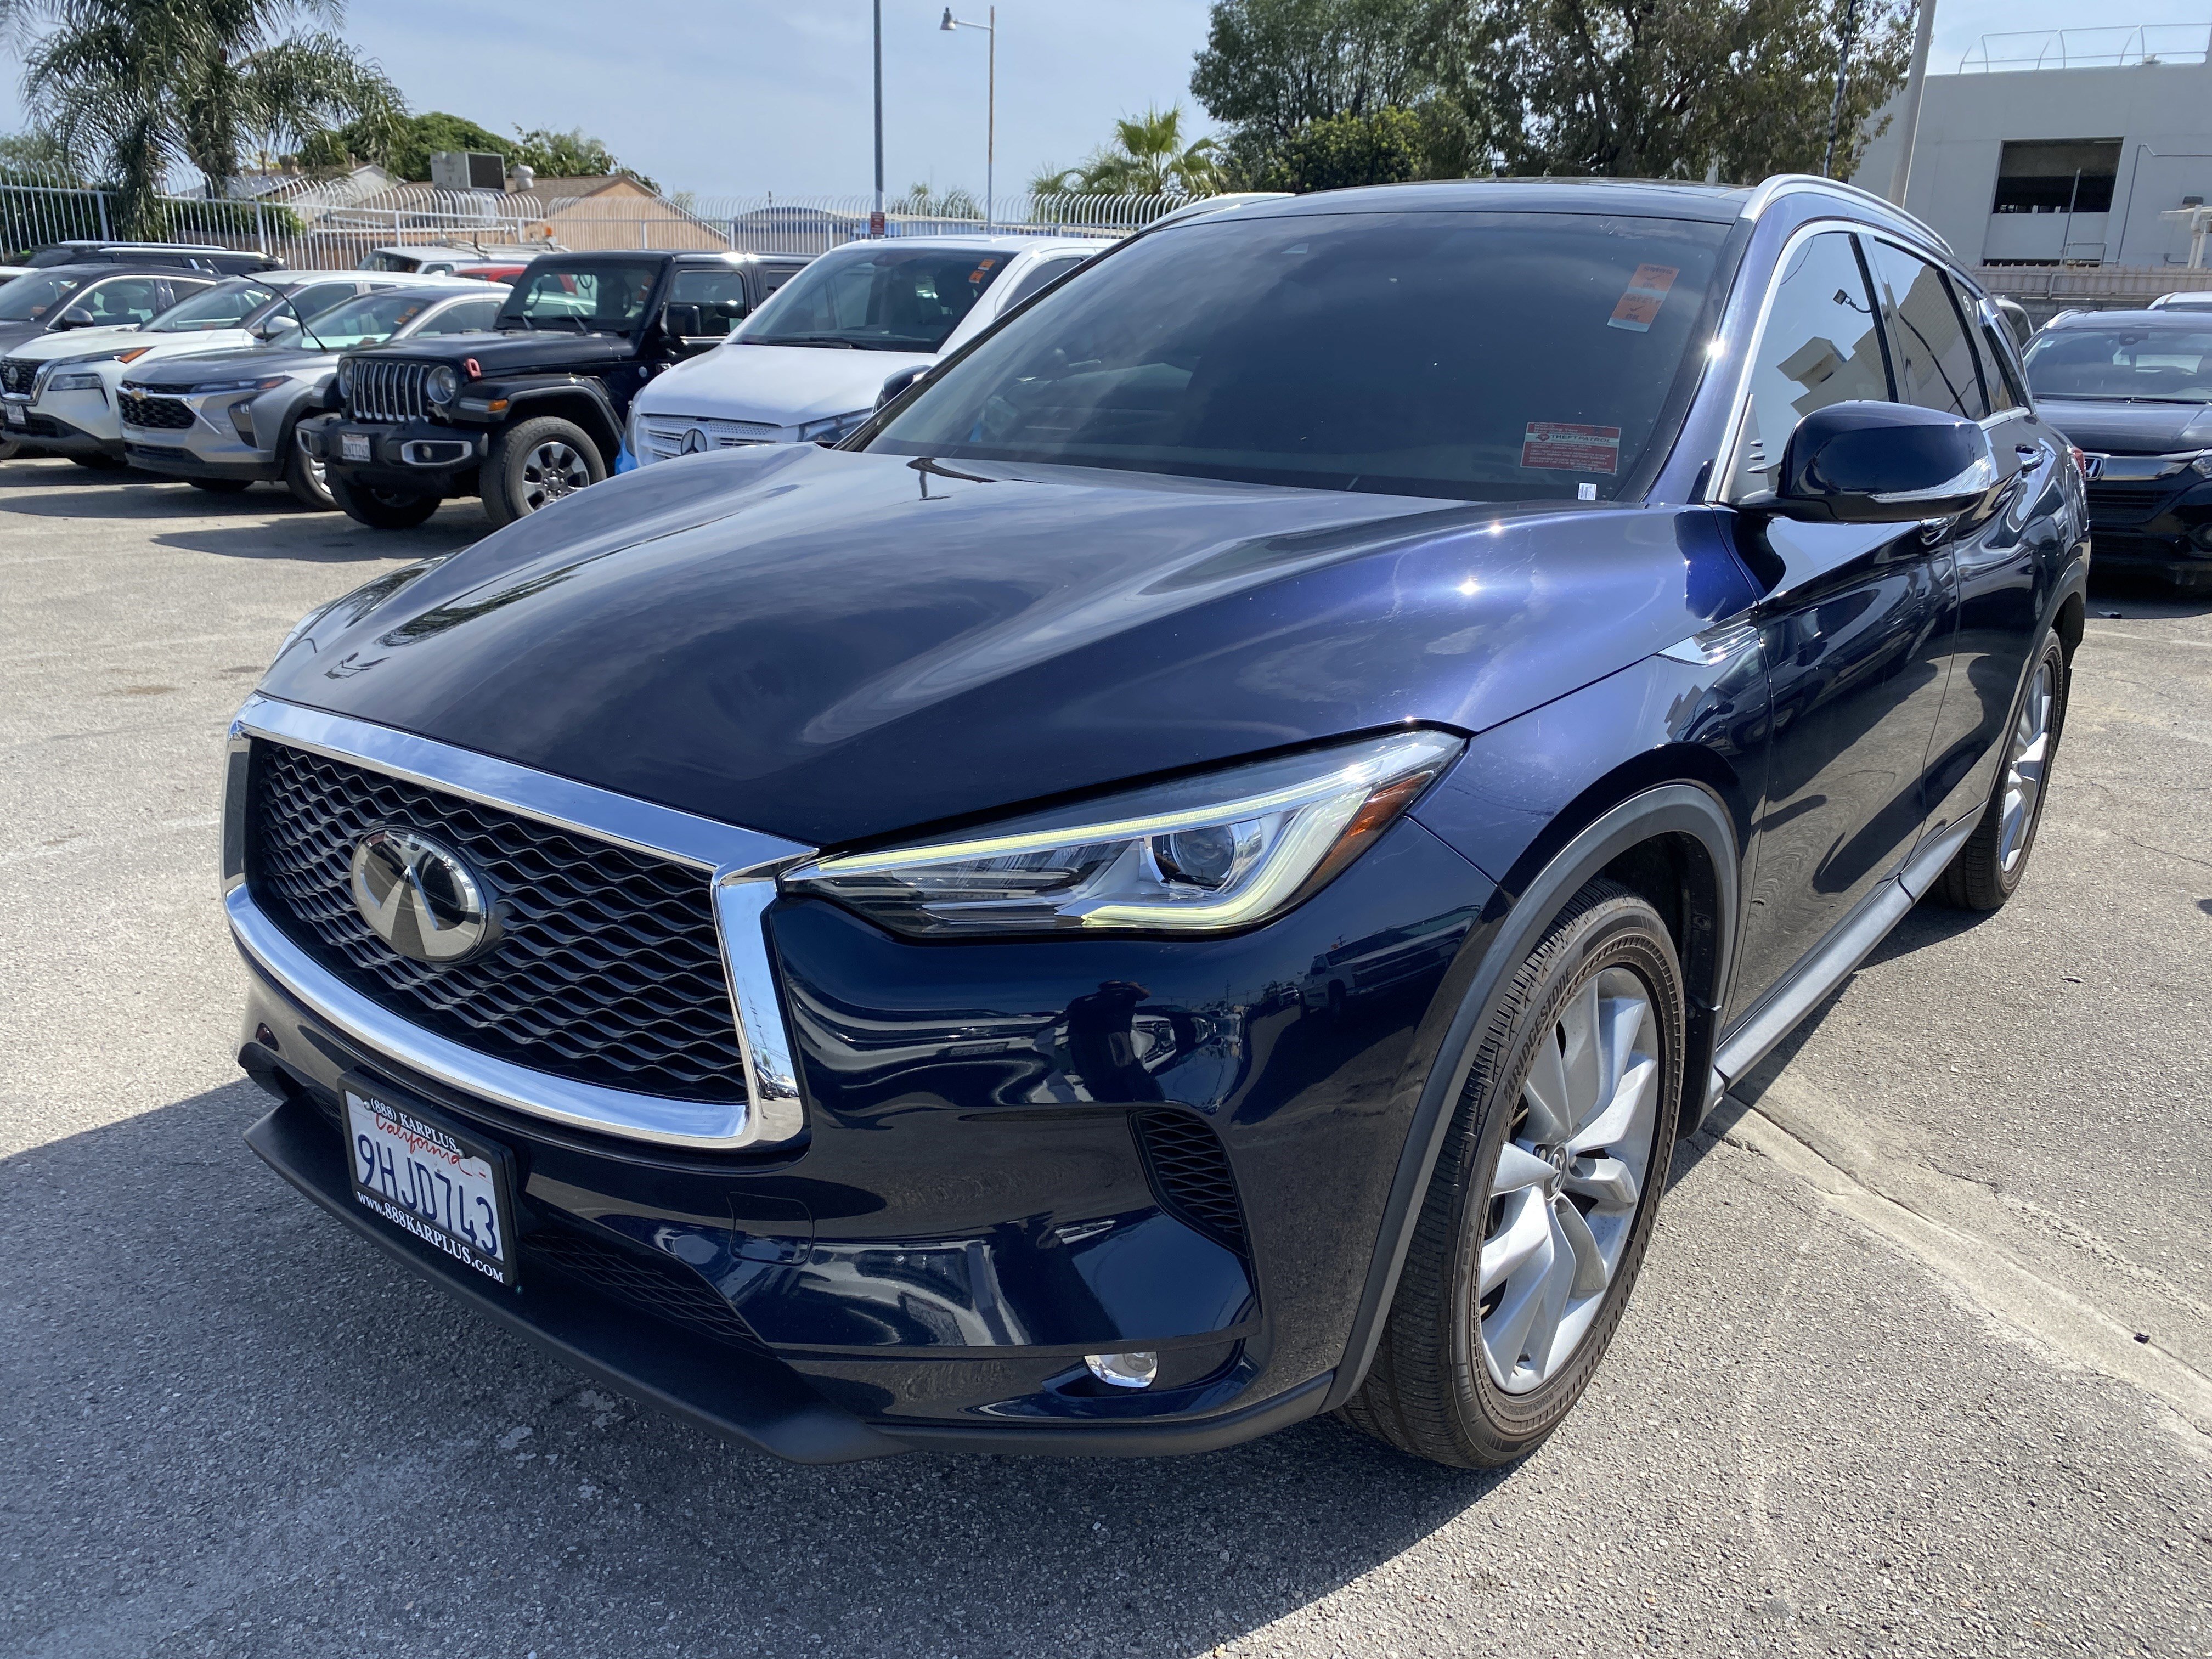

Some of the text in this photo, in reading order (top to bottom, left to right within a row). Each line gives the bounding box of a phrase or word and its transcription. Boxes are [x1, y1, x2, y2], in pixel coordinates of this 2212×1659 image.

[1504, 966, 1571, 1101] BRIDGESTONE
[370, 1098, 456, 1152] (888) KARPLUS
[375, 1113, 473, 1176] California
[358, 1133, 497, 1256] 9HJD743
